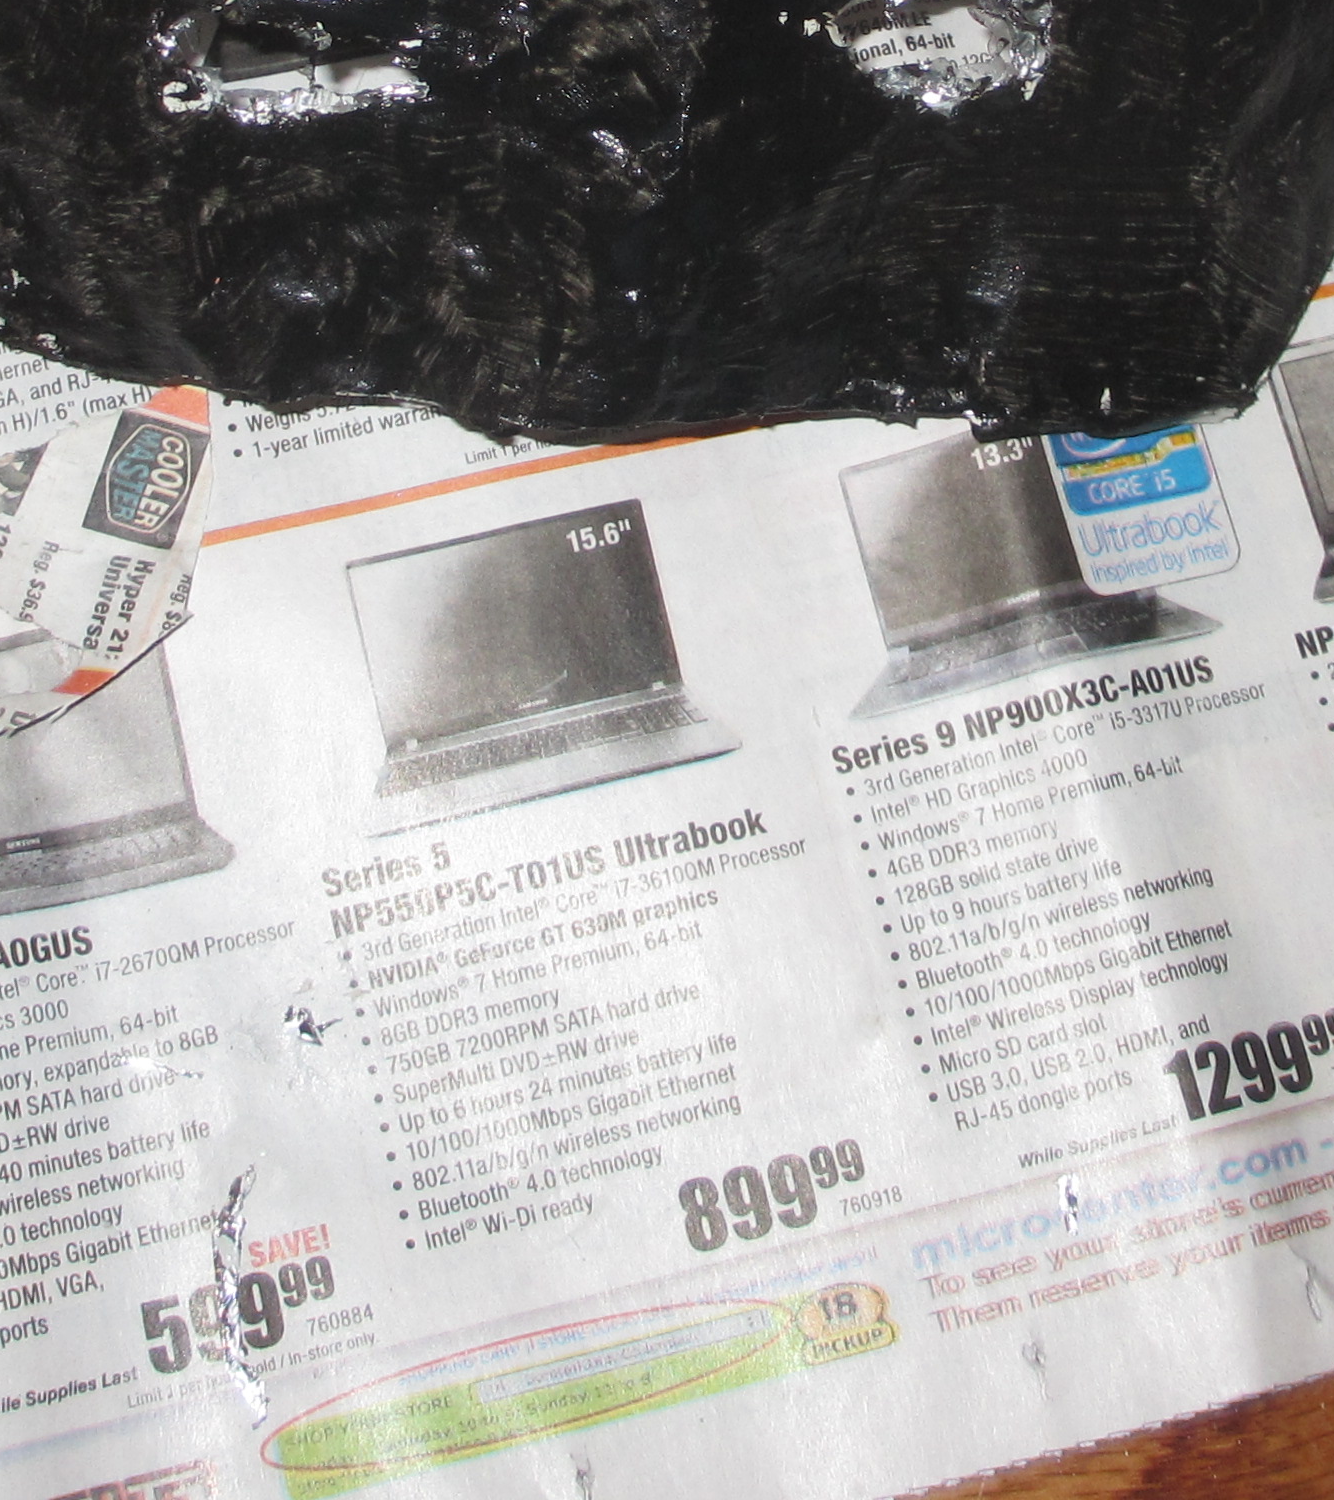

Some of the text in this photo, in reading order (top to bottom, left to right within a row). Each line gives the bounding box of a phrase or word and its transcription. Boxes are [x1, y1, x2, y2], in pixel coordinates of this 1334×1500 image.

[906, 33, 955, 54] 64-bit
[112, 428, 184, 535] COOLER MASTER
[1087, 470, 1148, 506] CORE
[1078, 500, 1220, 561] Ultrabook
[832, 734, 928, 774] Series
[936, 721, 955, 748] 9
[615, 809, 767, 864] Ultrabook
[322, 842, 450, 897] Series 5
[895, 840, 1096, 904] 128GB solid state drive
[0, 1162, 22, 1183] 40
[29, 1149, 102, 1178] minutes
[107, 1133, 173, 1161] battery
[181, 1121, 209, 1141] life
[248, 1224, 331, 1270] SAVE!
[25, 1378, 96, 1416] Supplies
[99, 1366, 138, 1388] Last
